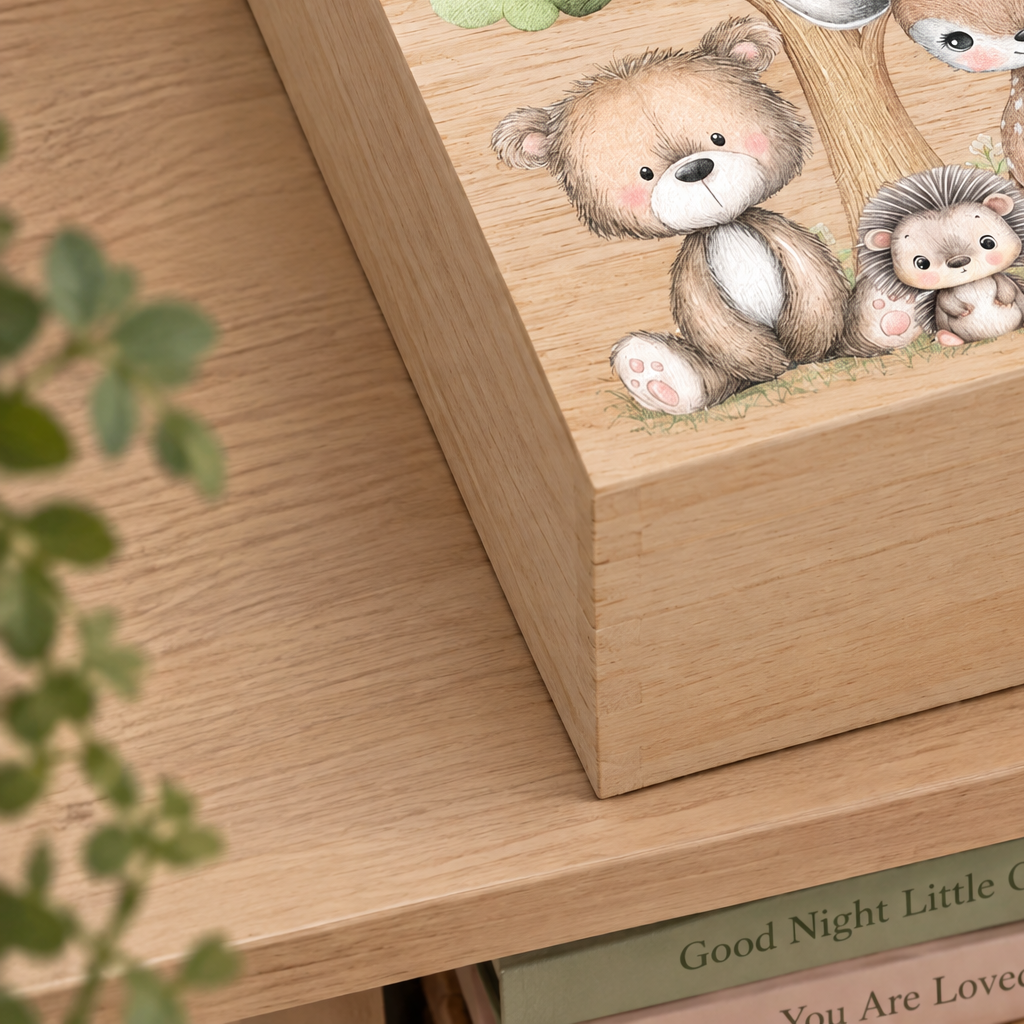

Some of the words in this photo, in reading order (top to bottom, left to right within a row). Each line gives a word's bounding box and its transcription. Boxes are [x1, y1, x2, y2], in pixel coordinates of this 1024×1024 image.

[679, 921, 777, 971] Good
[788, 899, 890, 944] Night
[901, 872, 995, 918] Little
[858, 990, 921, 1022] Are
